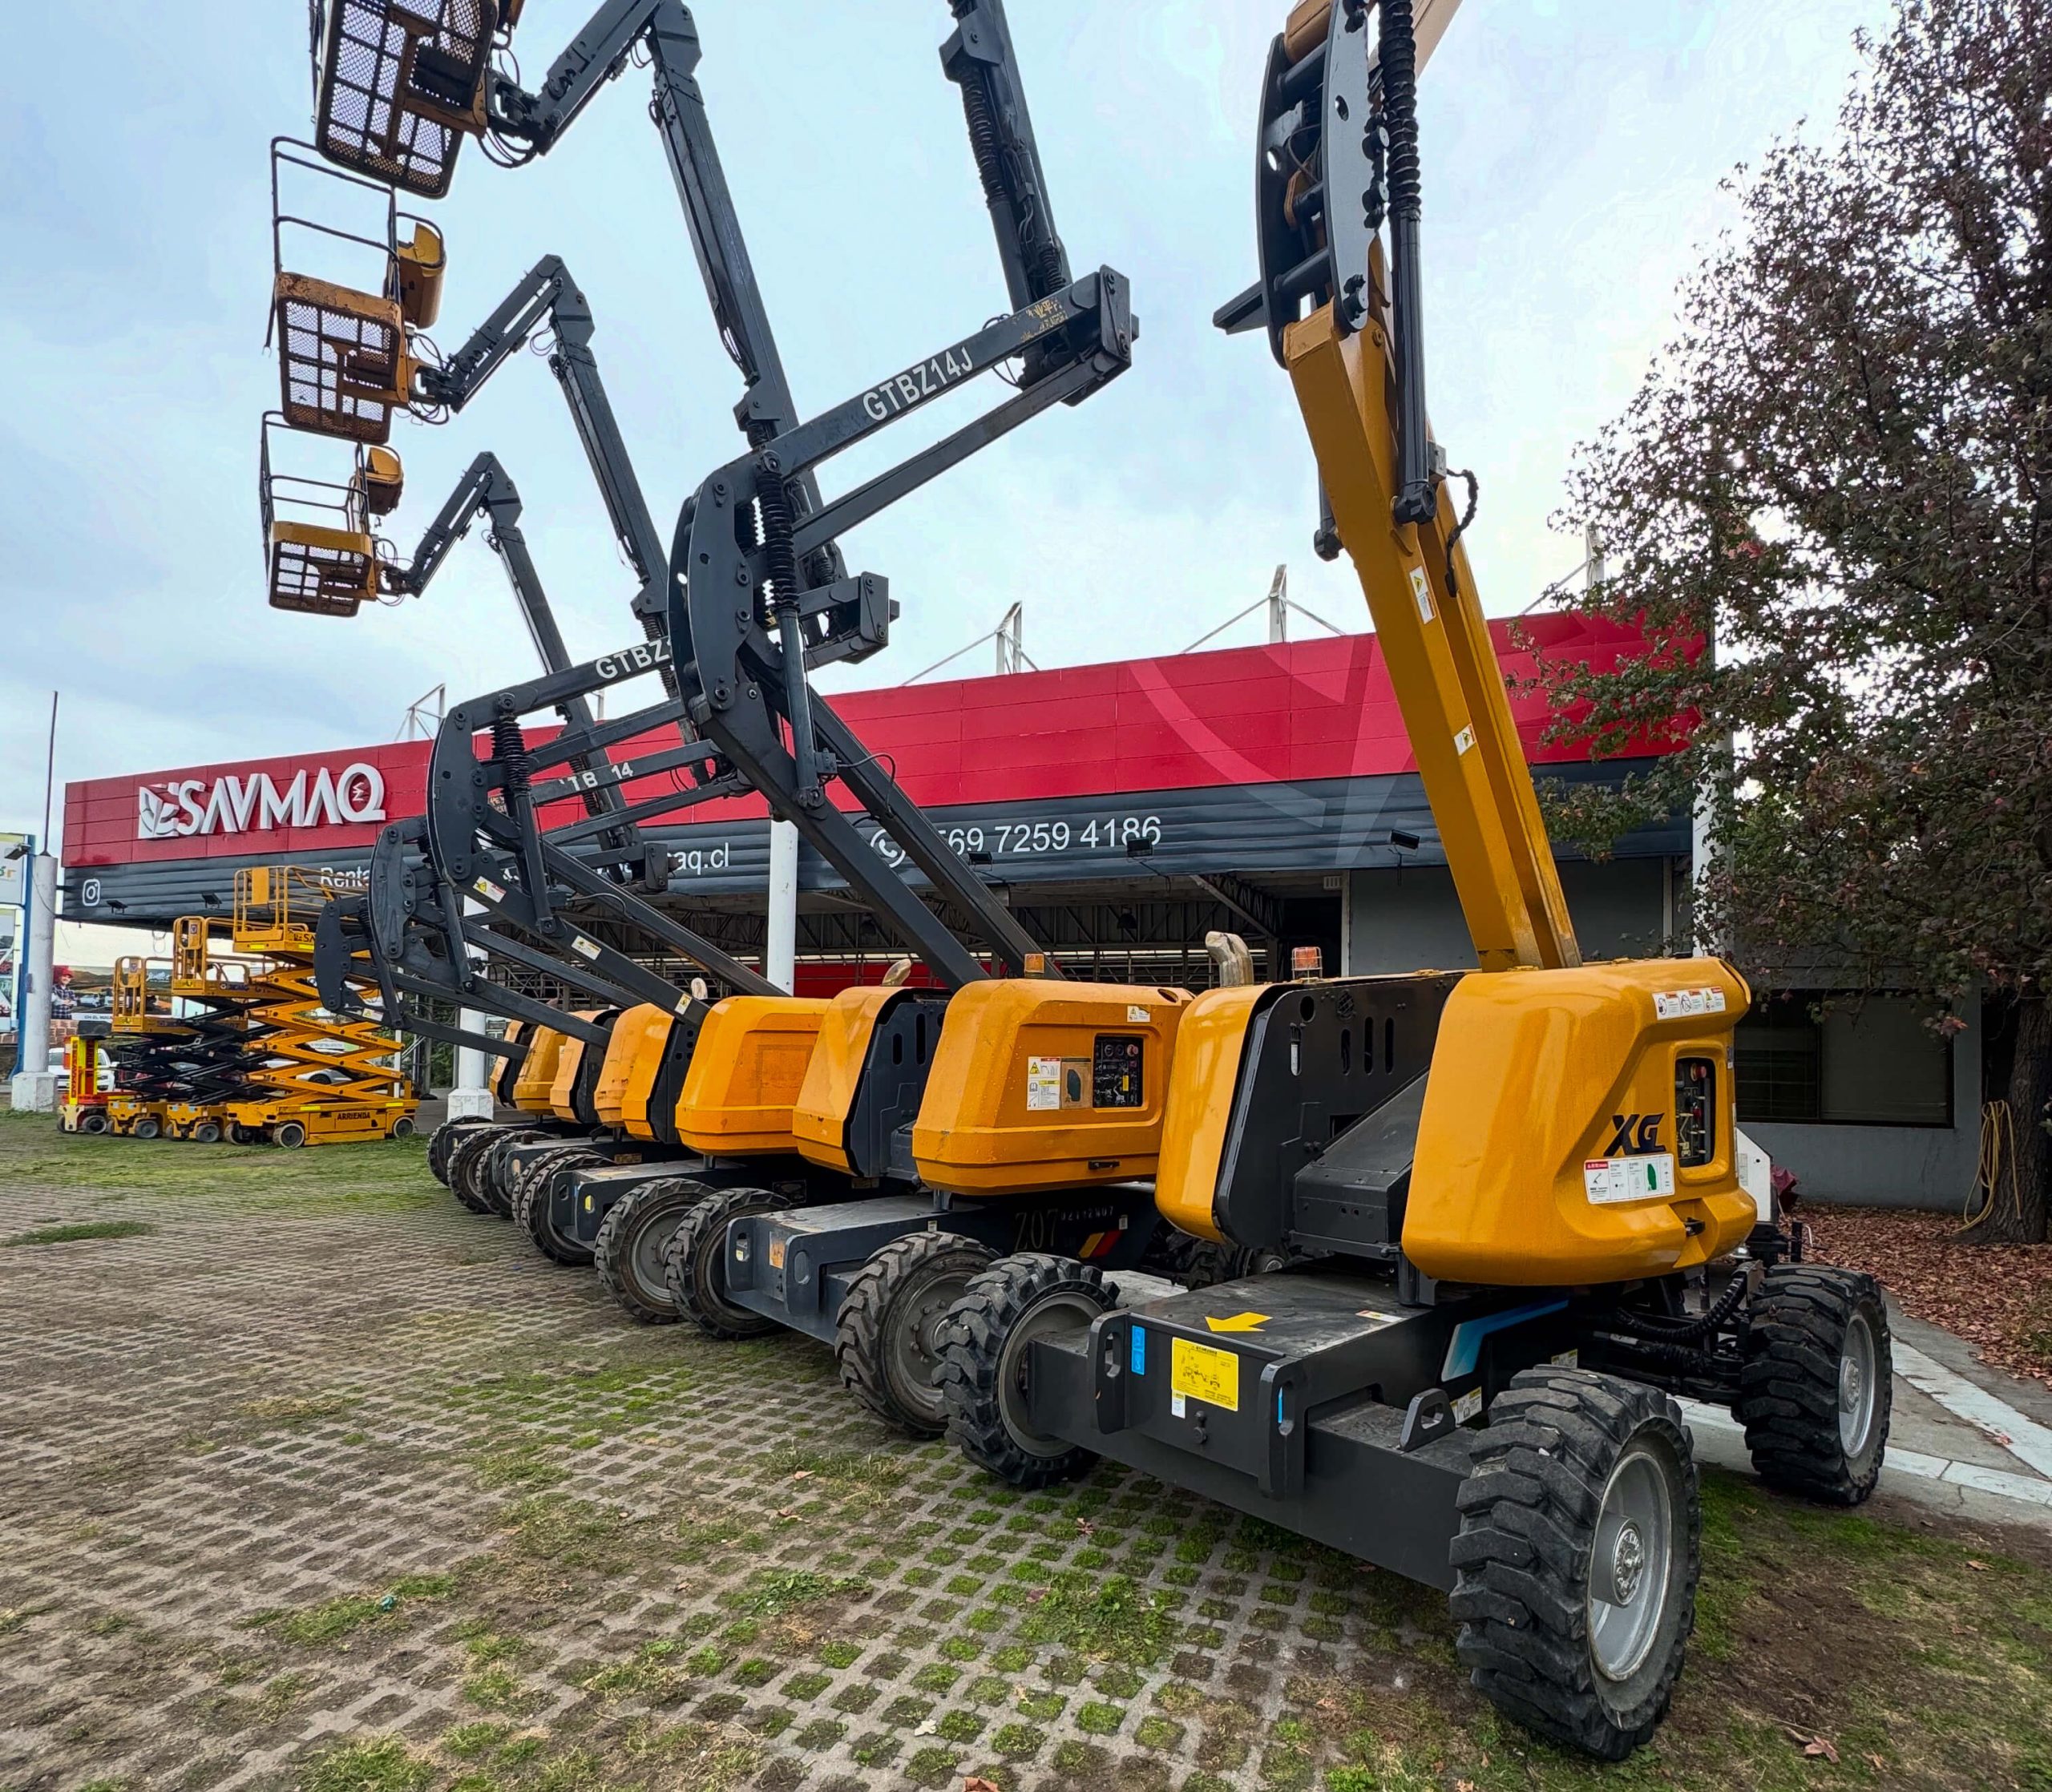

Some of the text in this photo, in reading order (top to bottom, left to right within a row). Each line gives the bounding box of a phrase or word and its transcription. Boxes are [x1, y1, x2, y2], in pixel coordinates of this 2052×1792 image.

[862, 346, 973, 421] GTBZ14J
[596, 640, 672, 679] GTBZ
[176, 762, 386, 836] SAVMAQ
[994, 821, 1070, 853] 7259
[1080, 815, 1161, 848] 4186
[667, 842, 729, 875] aq.cl
[337, 1112, 370, 1120] ARRIENDA
